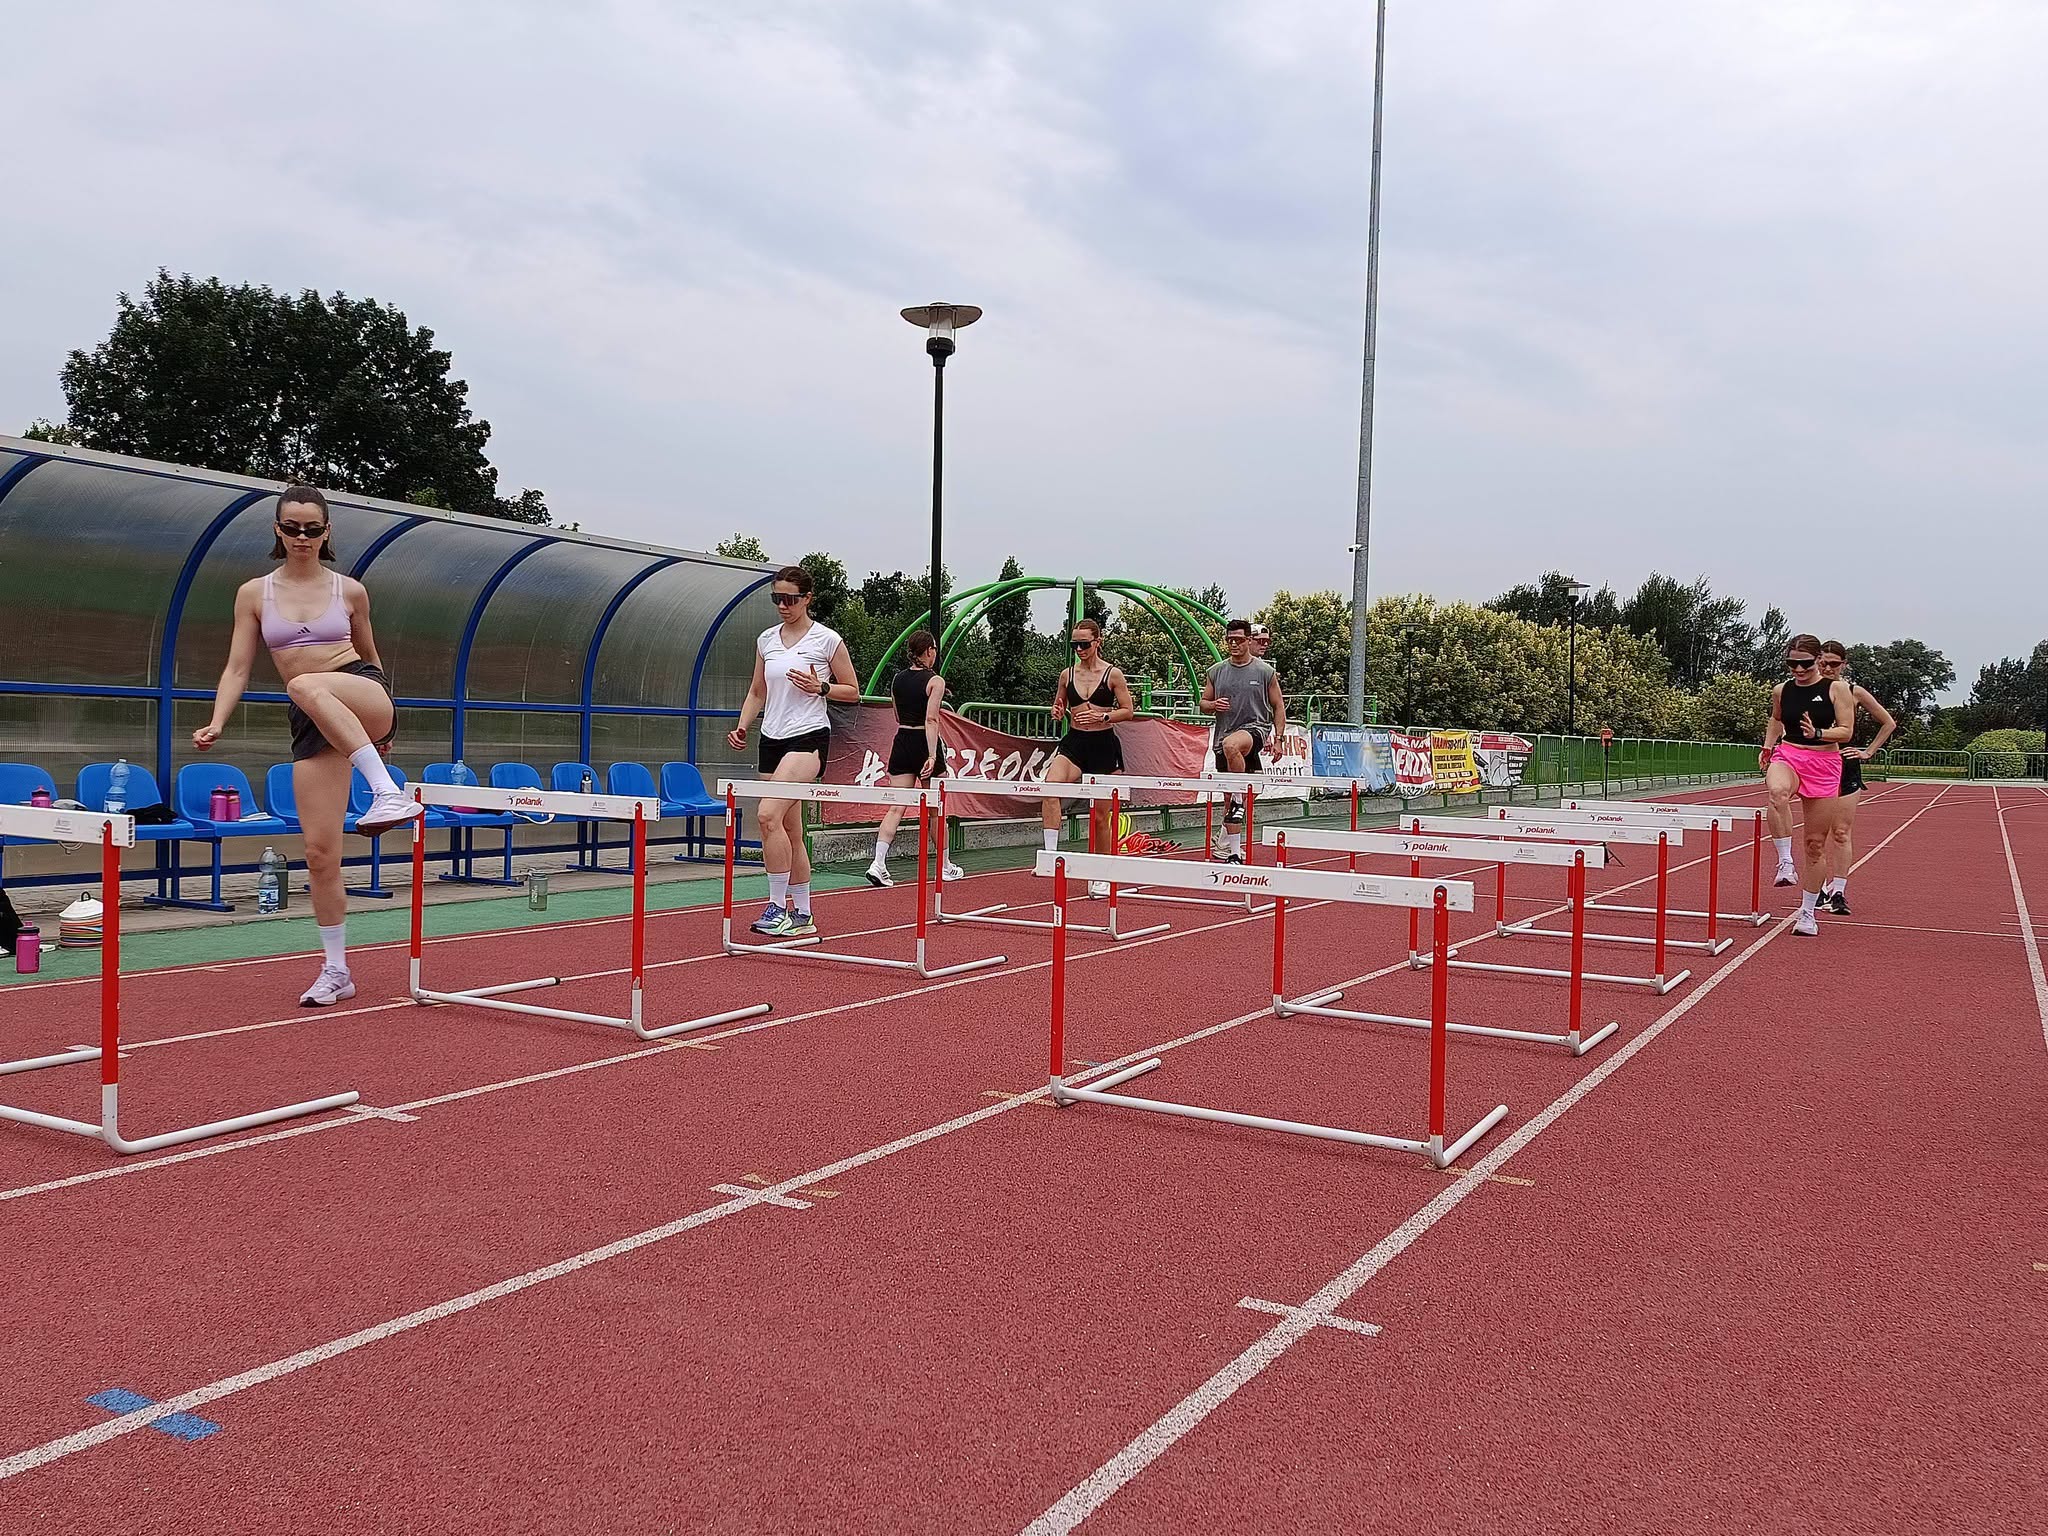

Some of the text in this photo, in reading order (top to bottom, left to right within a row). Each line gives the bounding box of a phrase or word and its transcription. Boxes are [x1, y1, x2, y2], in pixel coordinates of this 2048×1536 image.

[815, 789, 840, 797] polanik
[515, 796, 543, 806] polanik
[1596, 814, 1623, 822] polanik
[1525, 826, 1556, 834] polanik
[1411, 842, 1448, 852] polanik
[1222, 874, 1269, 887] polanik
